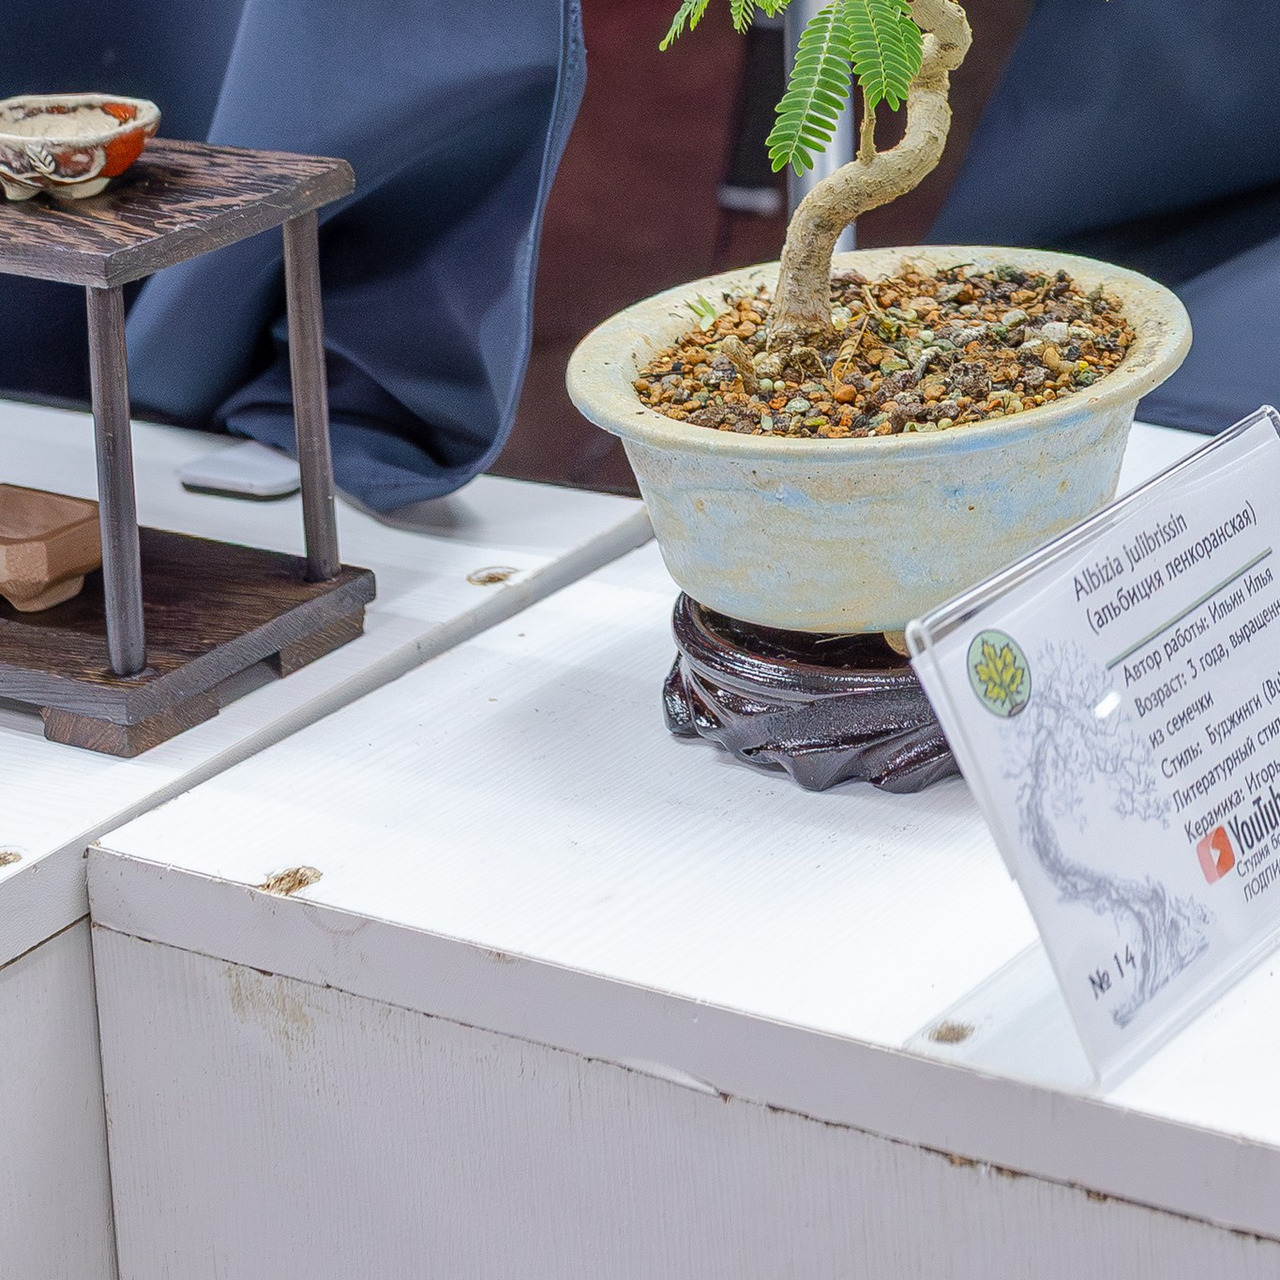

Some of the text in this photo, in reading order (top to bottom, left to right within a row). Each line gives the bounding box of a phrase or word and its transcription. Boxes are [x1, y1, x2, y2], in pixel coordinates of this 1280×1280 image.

[1072, 512, 1188, 603] Albizia julibrissin
[1085, 498, 1257, 636] (альбиция ленкоранская)
[1122, 566, 1274, 688] Автор работы: Ильин Илья
[1133, 671, 1188, 719] Возраст:
[1198, 642, 1230, 672] года,
[1147, 690, 1215, 750] из семечки
[1159, 740, 1203, 779] Стиль:
[1203, 692, 1263, 746] Буджинги
[1171, 734, 1257, 814] Литературный
[1182, 787, 1246, 845] Керамика:
[1233, 842, 1271, 878] Студия
[1112, 943, 1137, 979] 14
